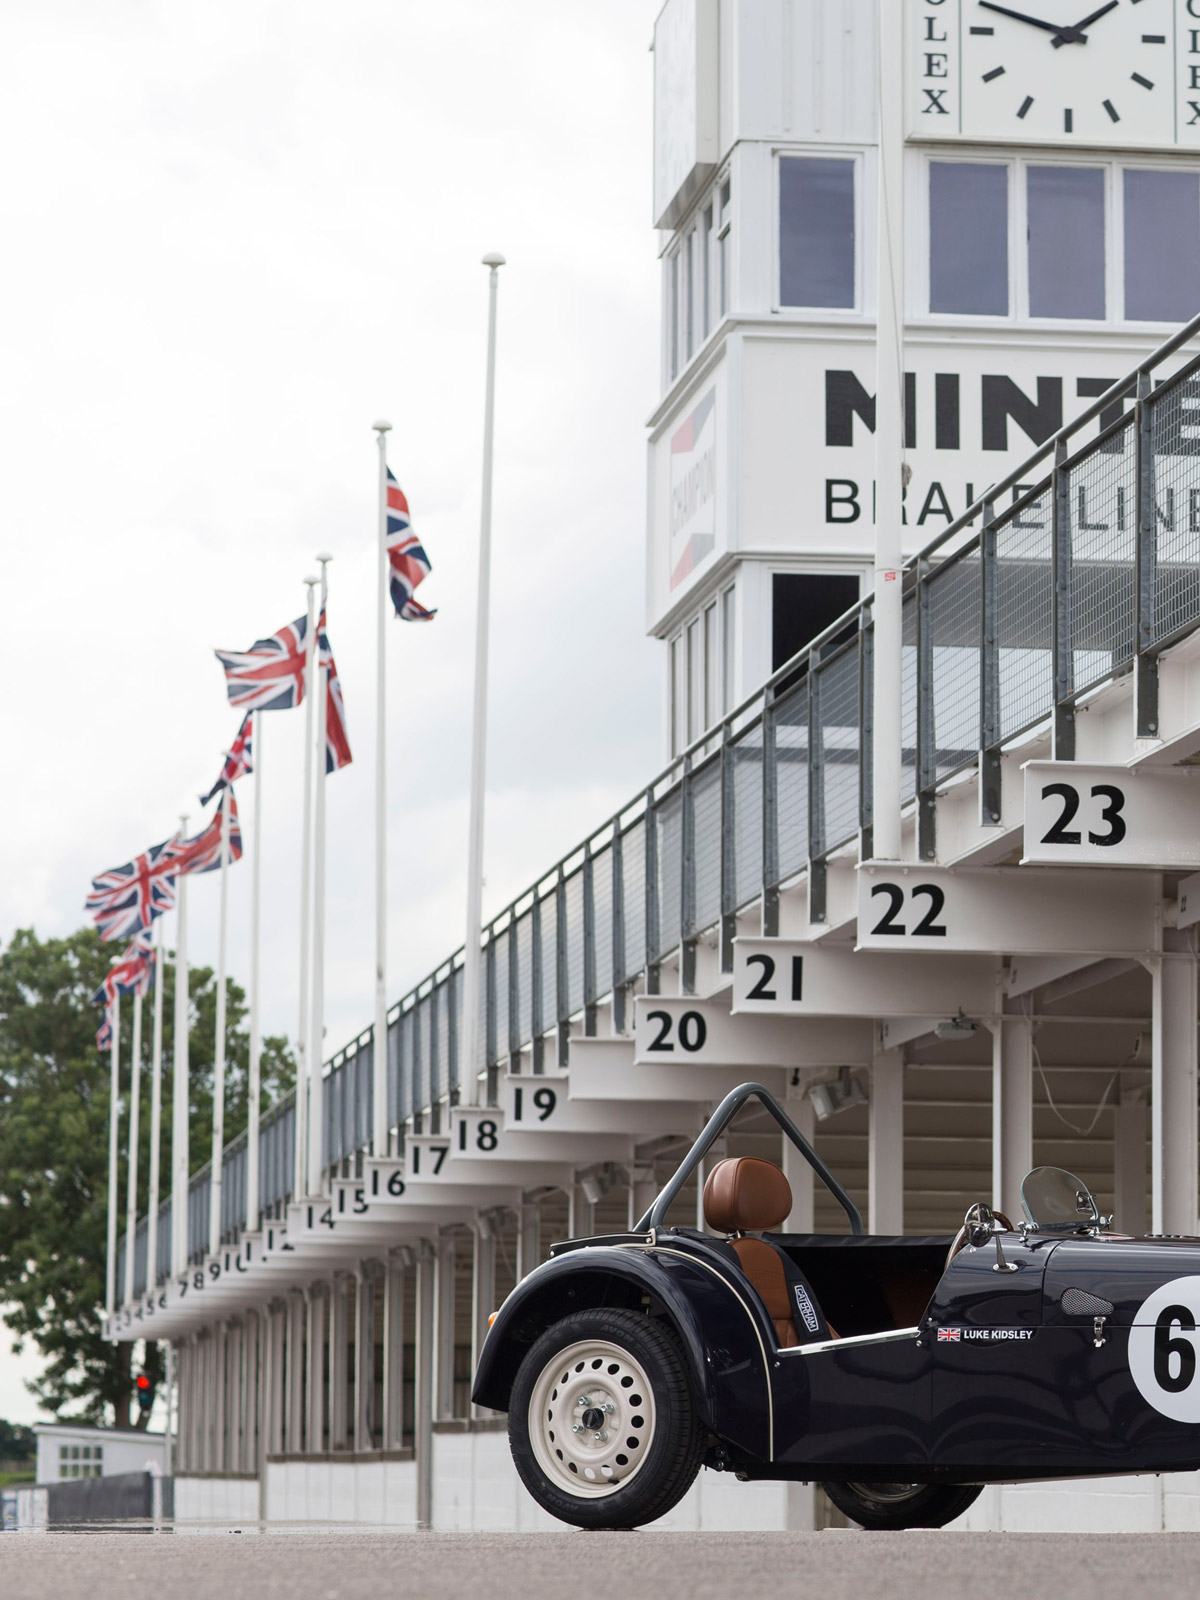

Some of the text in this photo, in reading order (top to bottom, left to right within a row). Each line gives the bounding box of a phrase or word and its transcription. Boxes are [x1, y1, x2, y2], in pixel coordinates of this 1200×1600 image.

[921, 0, 950, 115] LEX
[1040, 783, 1126, 846] 23
[870, 883, 947, 936] 22
[745, 954, 803, 1001] 21
[646, 1010, 707, 1052] 20
[514, 1087, 557, 1122] 19
[458, 1119, 499, 1151] 18
[412, 1146, 449, 1175] 17
[372, 1169, 405, 1196] 16
[339, 1189, 369, 1213] 15
[308, 1205, 334, 1229] 14
[193, 1272, 204, 1290] 8
[209, 1263, 221, 1280] 9
[179, 1280, 188, 1297] 7
[796, 1287, 816, 1329] CATERHAM
[601, 1325, 634, 1342] AVON
[964, 1331, 1033, 1339] LUKE KIDSLEY
